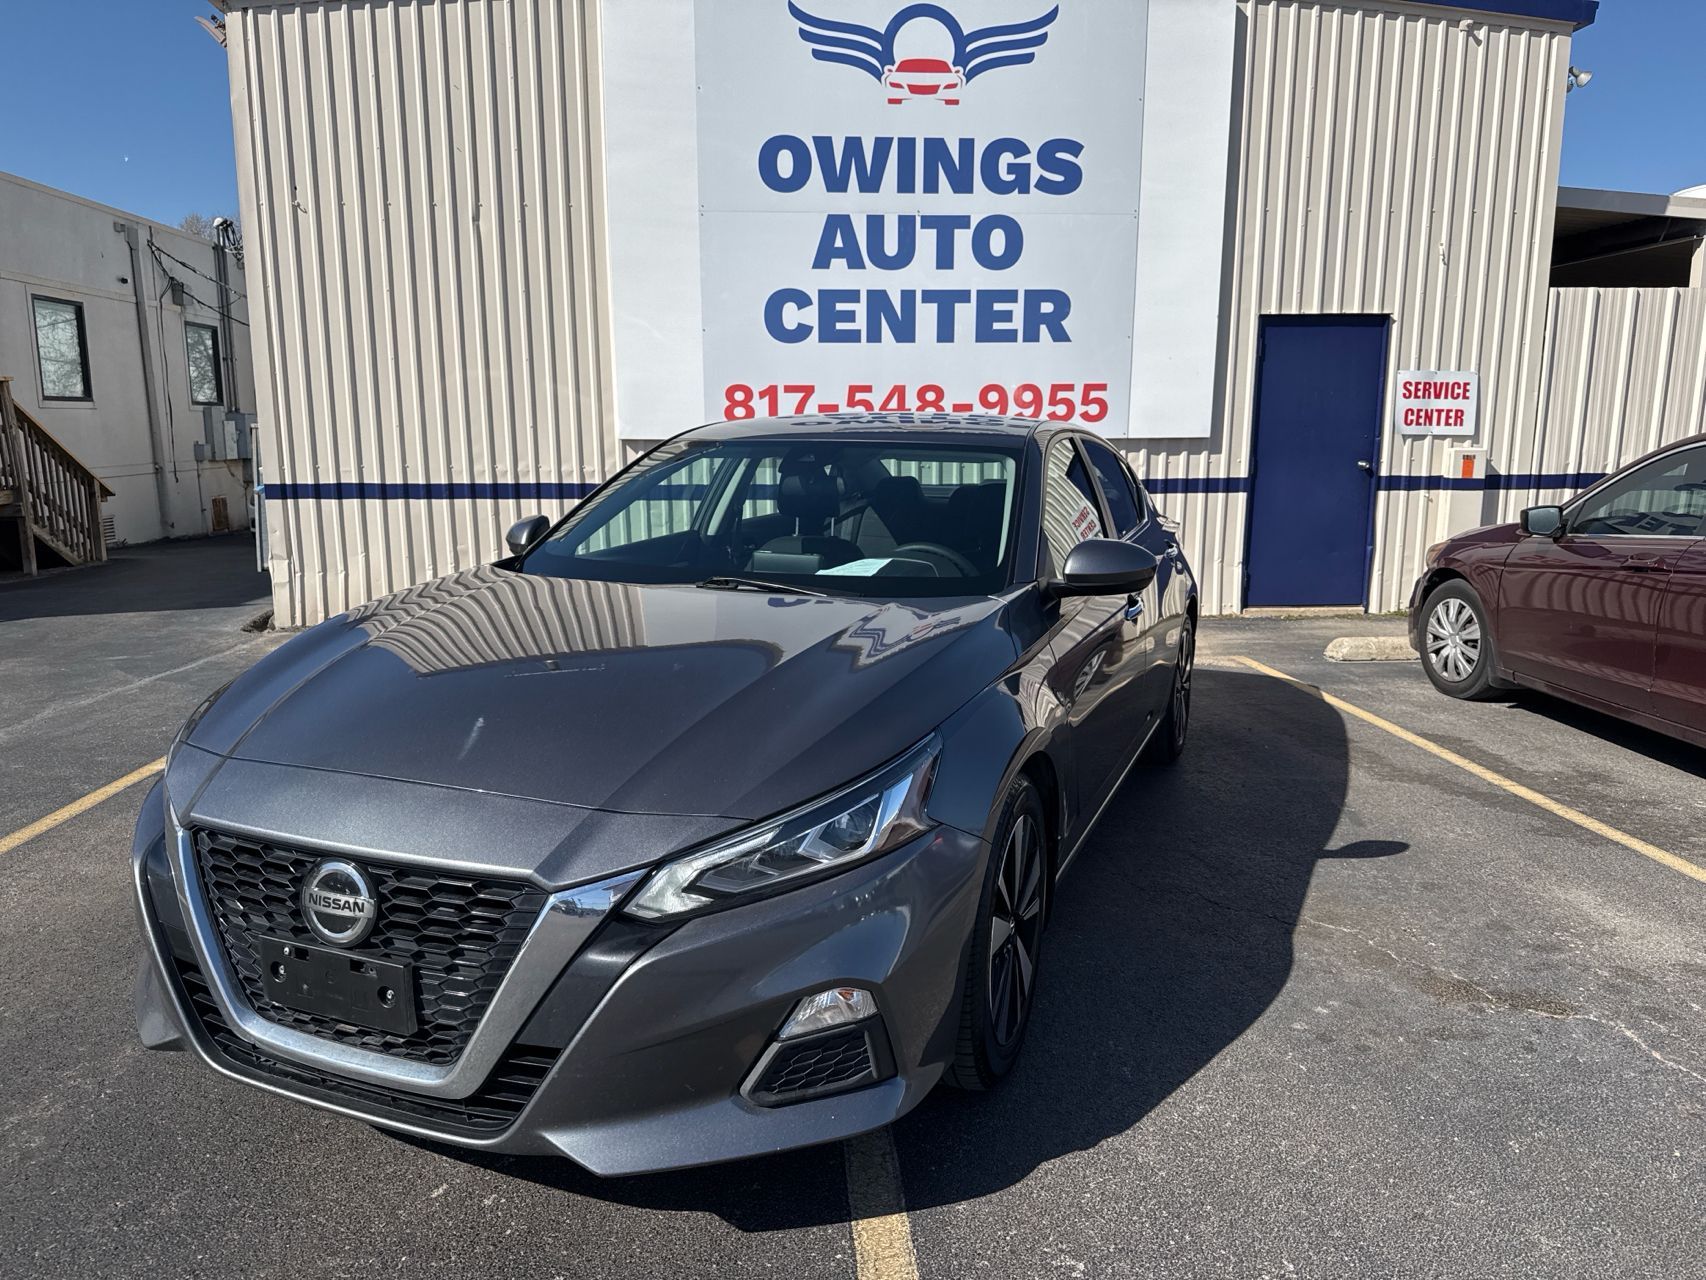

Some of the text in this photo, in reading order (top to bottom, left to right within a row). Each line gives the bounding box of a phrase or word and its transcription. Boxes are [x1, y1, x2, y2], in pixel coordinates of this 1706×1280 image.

[758, 134, 1085, 195] OWINGS
[812, 214, 1024, 270] AUTO
[763, 287, 1072, 343] CENTER
[723, 383, 1108, 422] 817-548-9955
[1402, 381, 1471, 400] SERVICE
[1403, 408, 1465, 427] CENTER
[308, 892, 365, 914] NISSAN
